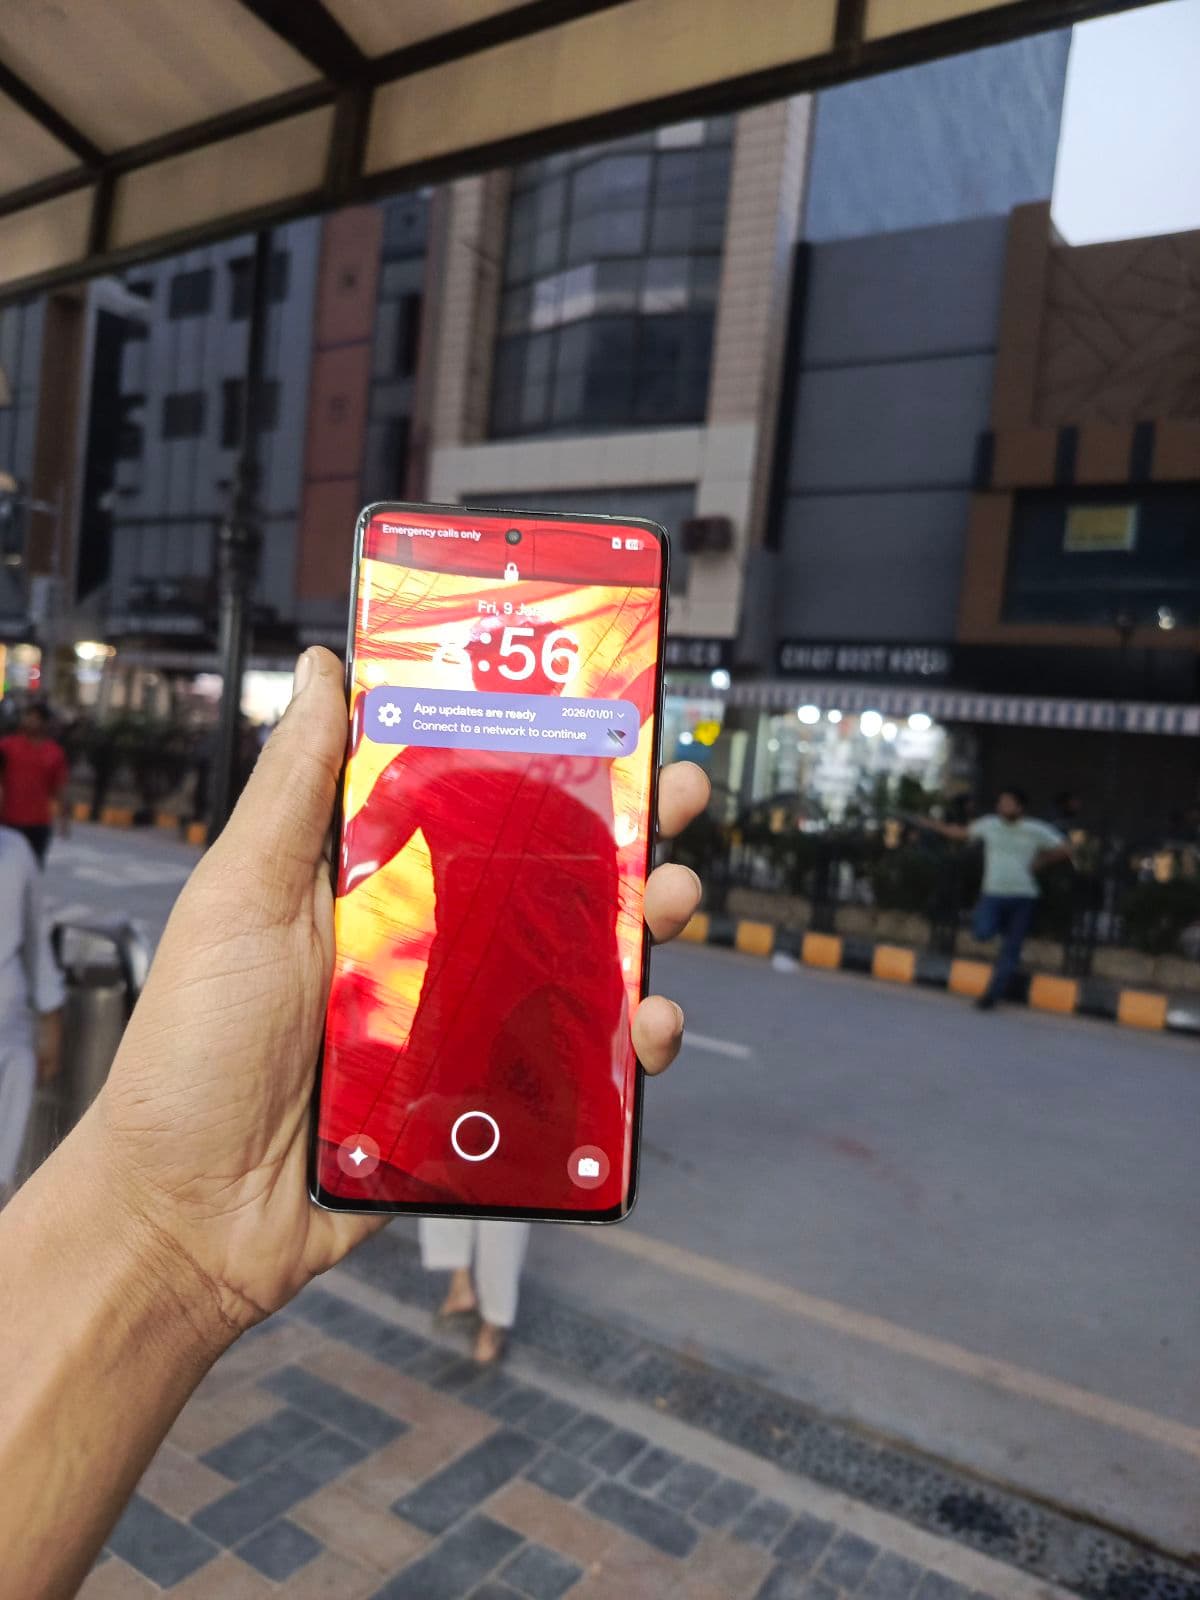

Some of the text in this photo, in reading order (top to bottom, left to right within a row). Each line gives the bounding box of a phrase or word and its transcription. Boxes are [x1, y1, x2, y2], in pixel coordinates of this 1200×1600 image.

[382, 523, 481, 541] Emergency calls only
[477, 600, 542, 617] Fri, 9 Ja
[413, 702, 536, 722] App updates are ready
[561, 707, 614, 719] 2026/01/01
[412, 720, 587, 740] Connect to a network to continue
